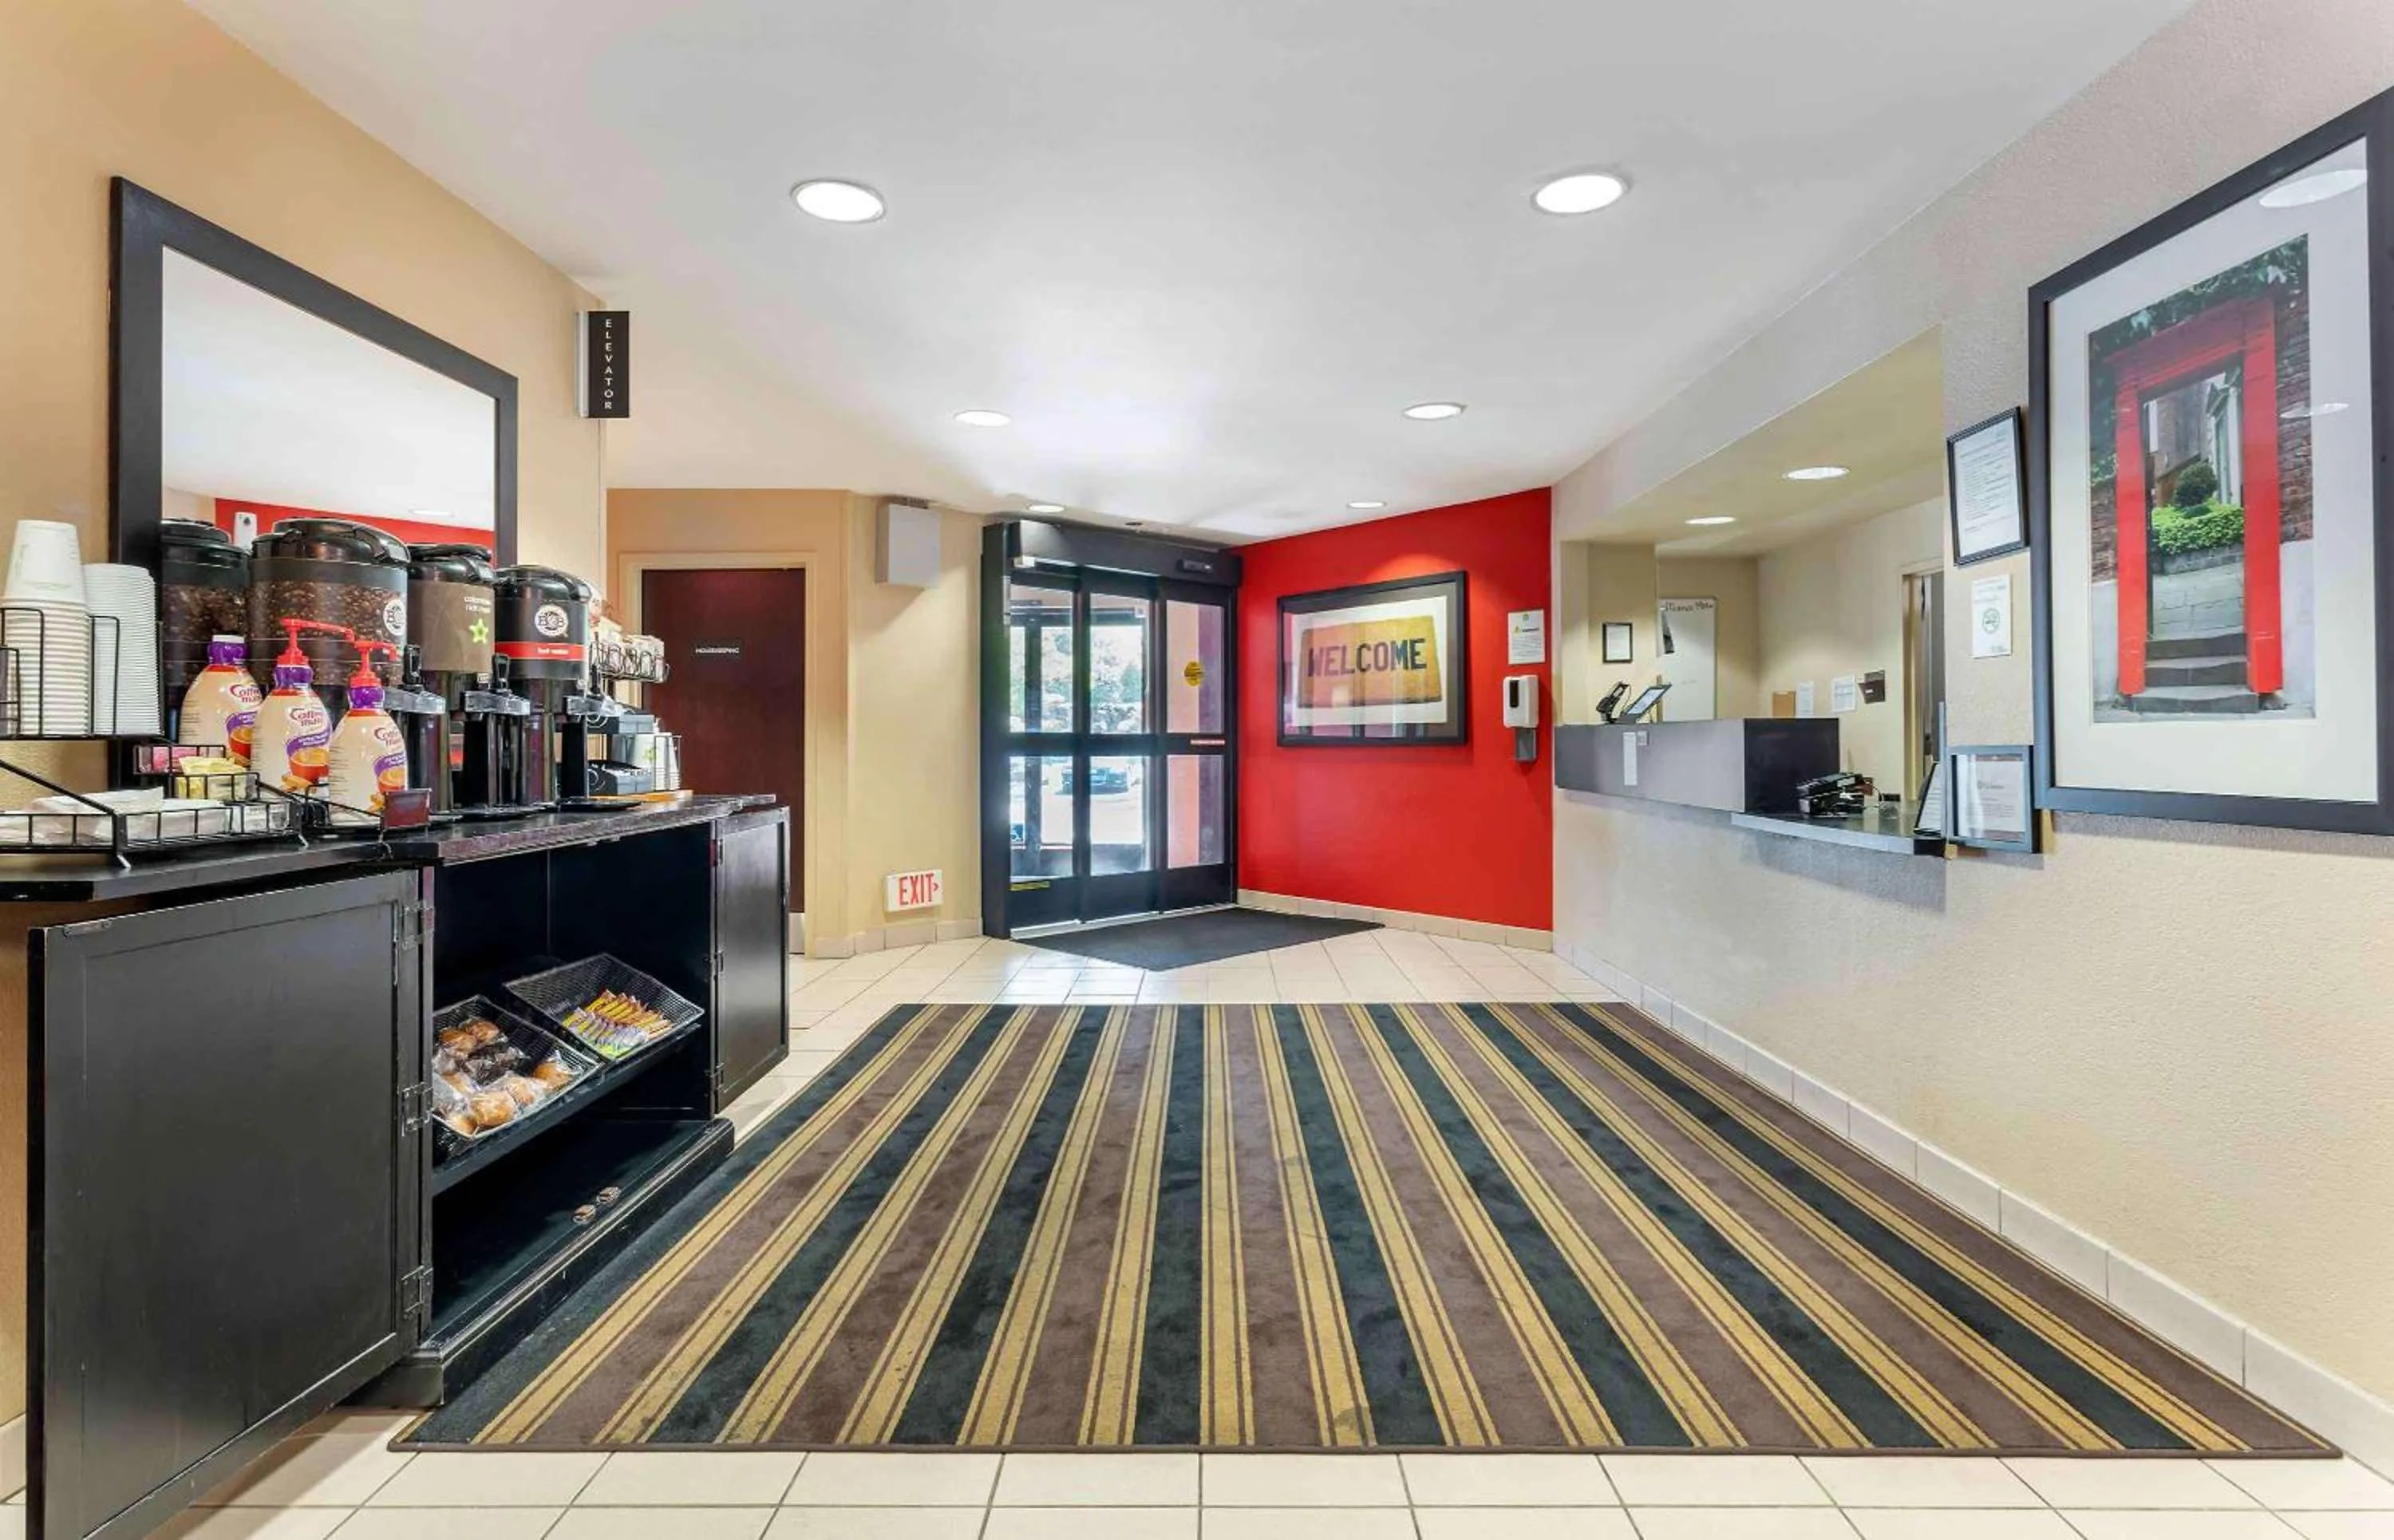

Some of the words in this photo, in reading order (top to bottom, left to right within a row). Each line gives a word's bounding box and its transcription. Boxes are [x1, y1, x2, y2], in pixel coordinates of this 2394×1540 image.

[604, 319, 614, 409] ELEVATOR
[1307, 638, 1428, 677] WELCOME
[899, 873, 934, 906] EXIT
